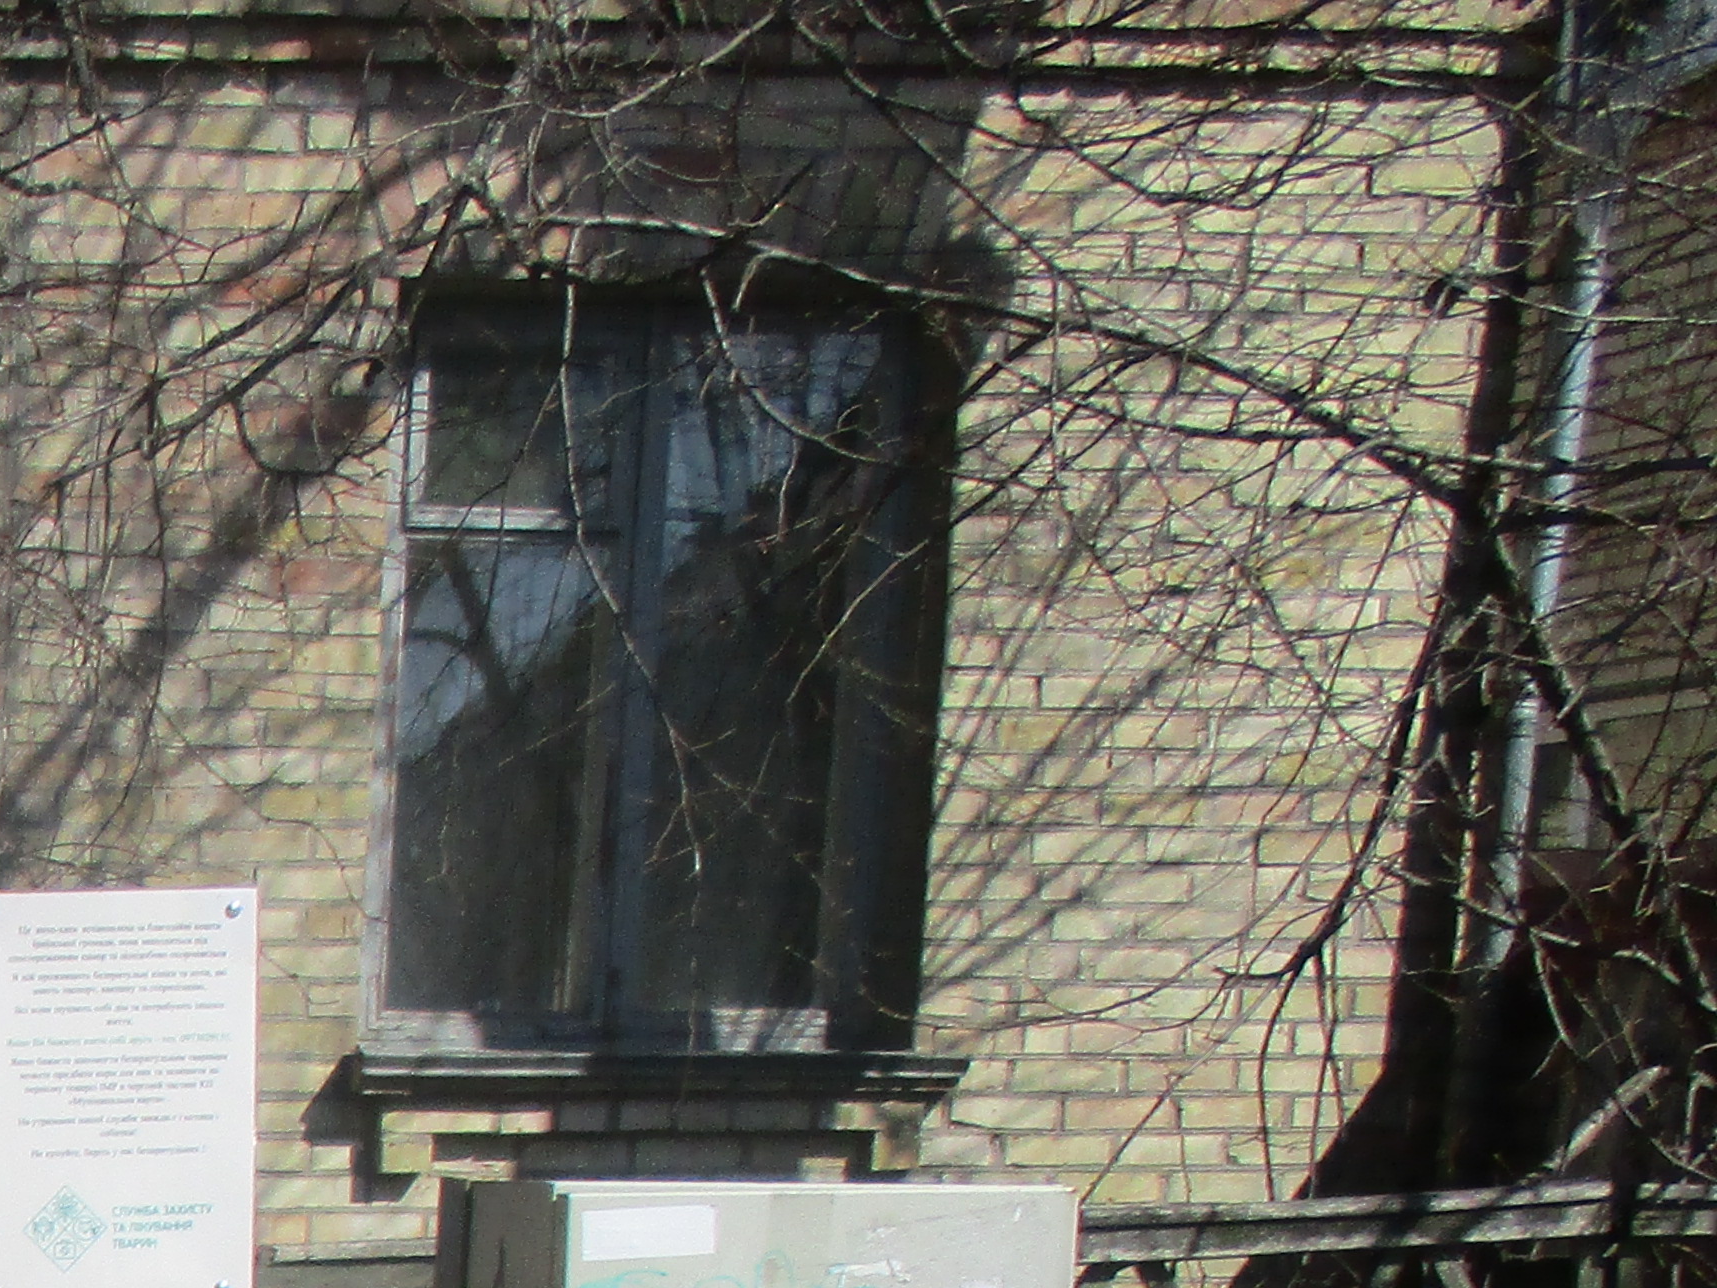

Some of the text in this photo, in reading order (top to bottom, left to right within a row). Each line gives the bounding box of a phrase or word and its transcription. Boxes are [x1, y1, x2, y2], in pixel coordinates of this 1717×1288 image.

[112, 1203, 214, 1217] СЛУЖБА ЗАХИСТУ
[113, 1238, 159, 1249] ТВАРИН
